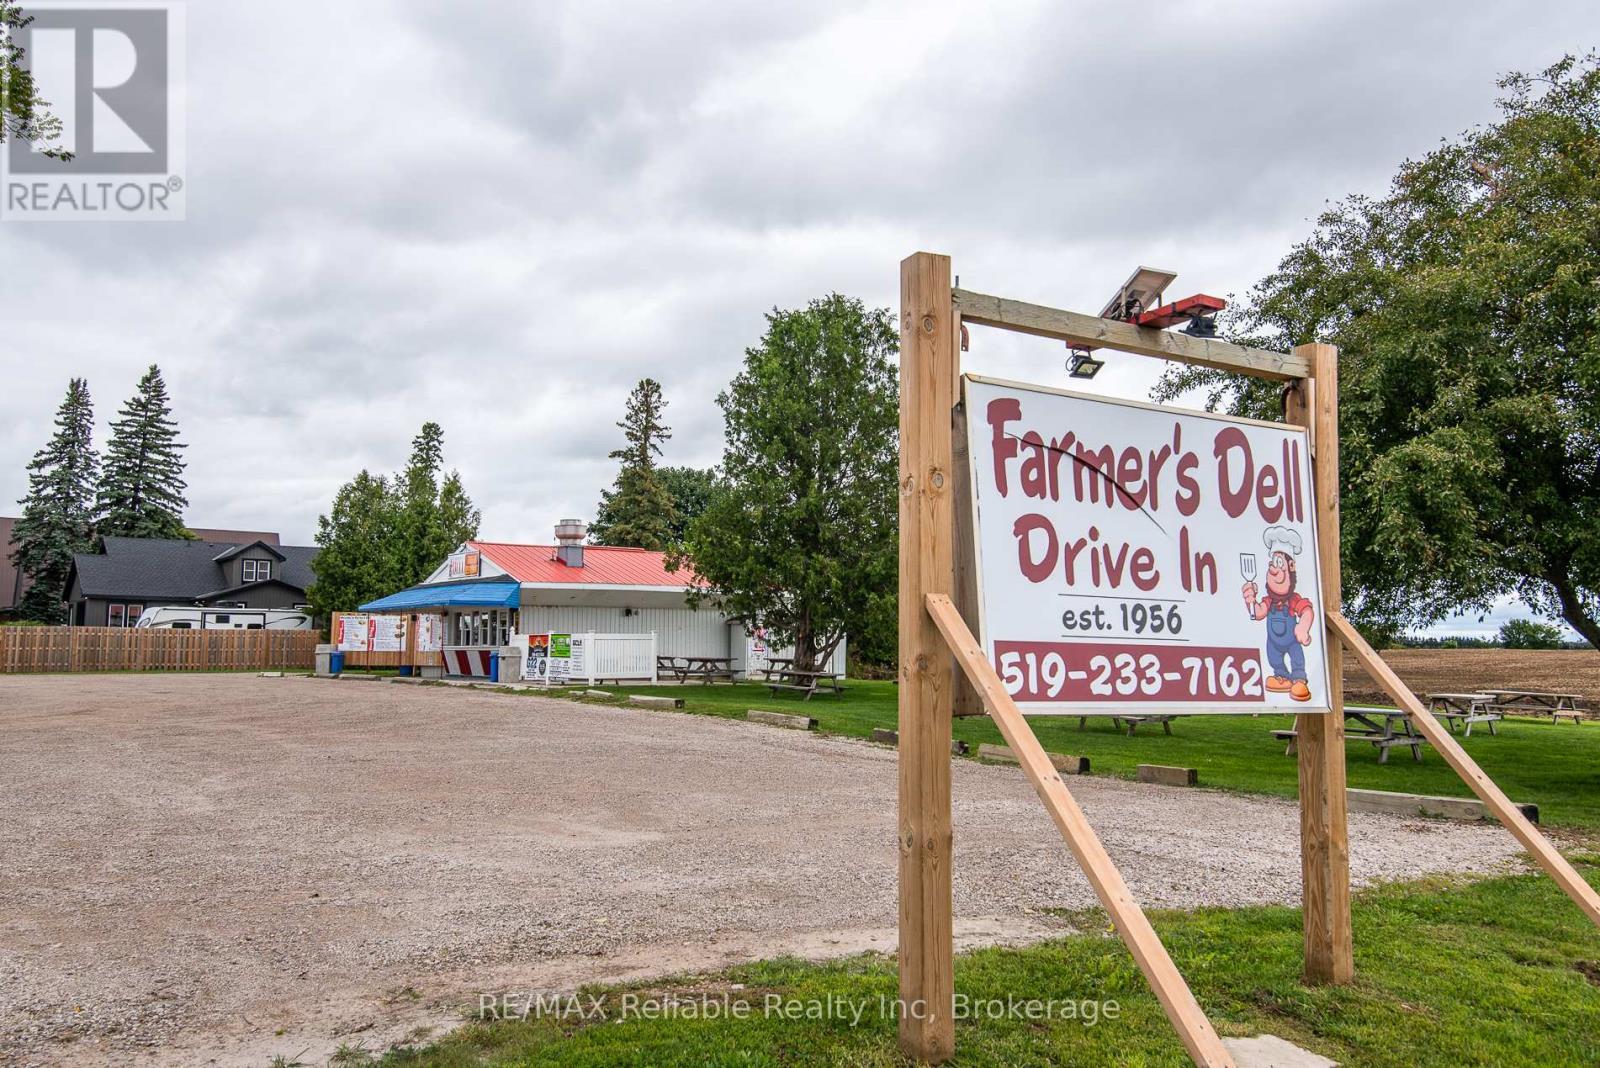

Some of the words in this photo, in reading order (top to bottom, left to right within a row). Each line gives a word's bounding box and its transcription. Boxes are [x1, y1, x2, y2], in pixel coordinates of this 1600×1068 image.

[986, 397, 1201, 517] Farmer's
[1213, 427, 1304, 524] Dell
[1013, 513, 1160, 592] Drive
[1179, 525, 1218, 595] In
[1062, 603, 1112, 631] est.
[1121, 602, 1183, 634] 1956
[1000, 651, 1262, 698] 519-233-7162
